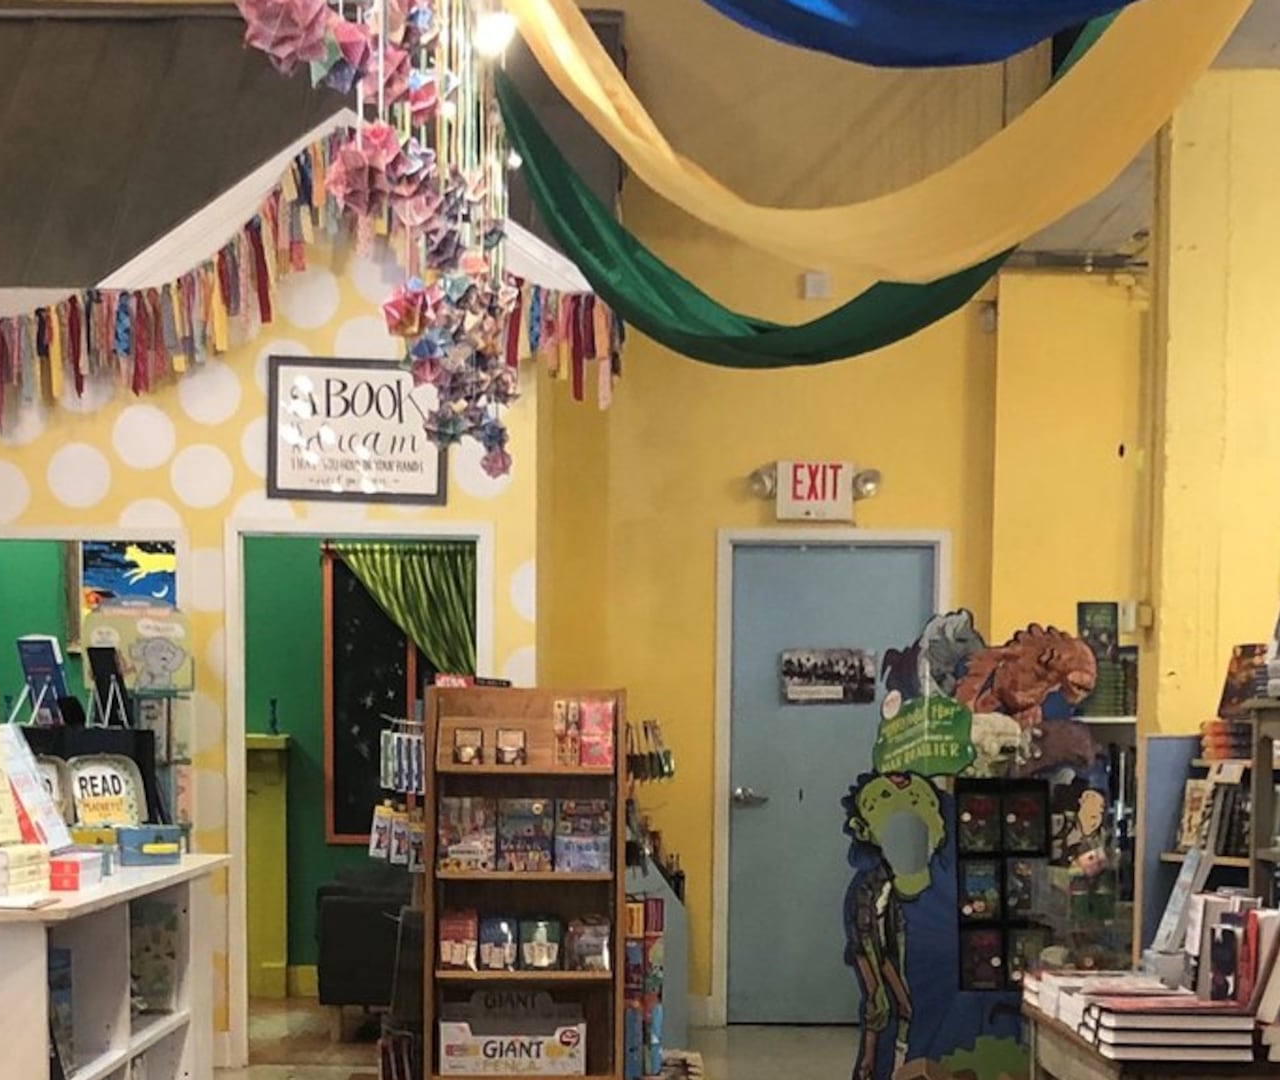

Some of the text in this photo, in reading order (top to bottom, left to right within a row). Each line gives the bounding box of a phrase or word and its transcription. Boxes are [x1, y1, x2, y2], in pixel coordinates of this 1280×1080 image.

[325, 378, 427, 424] BOOK
[791, 463, 843, 501] EXIT
[78, 774, 123, 799] READ
[482, 1039, 544, 1059] GIANT
